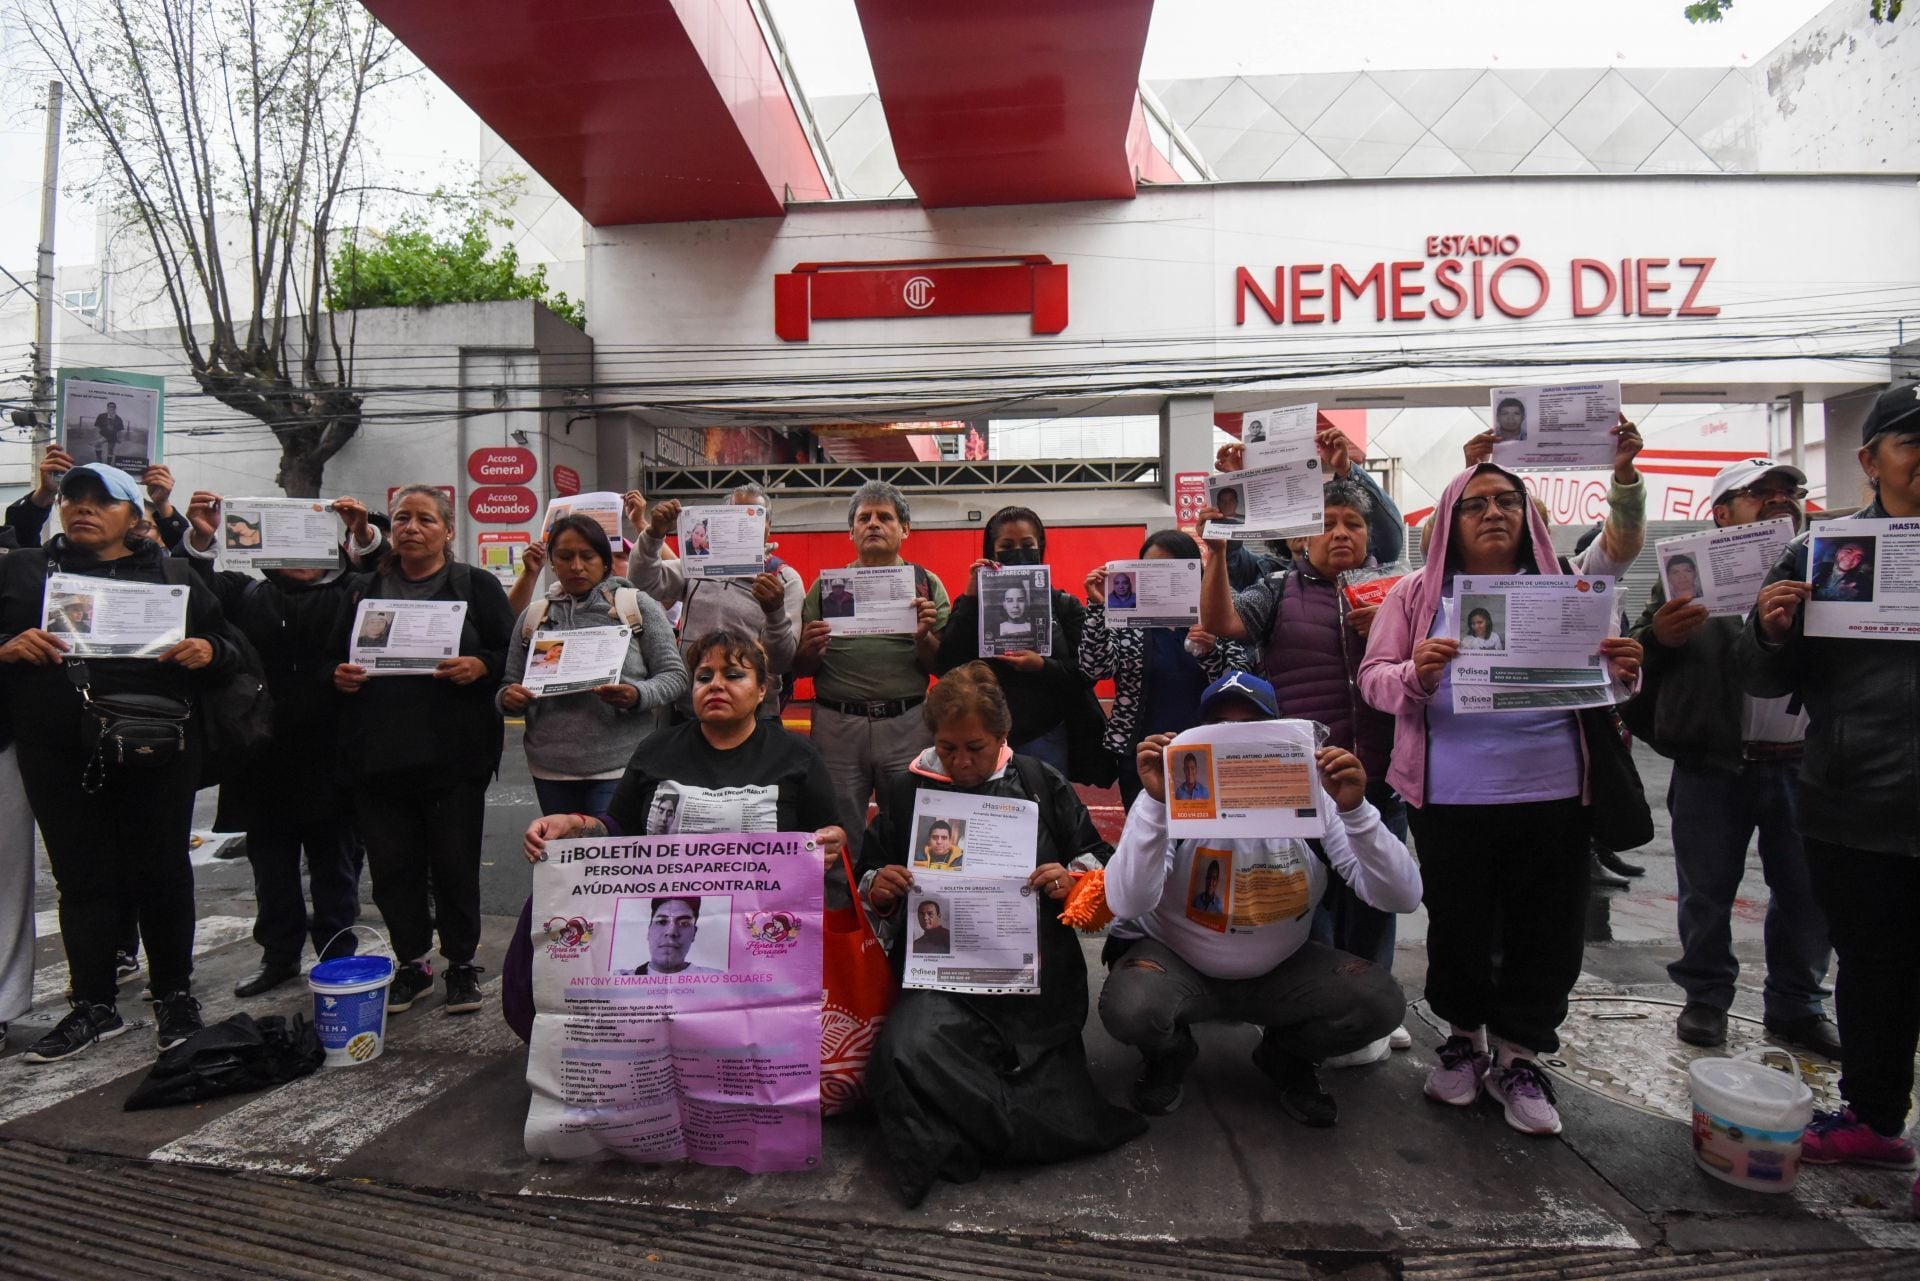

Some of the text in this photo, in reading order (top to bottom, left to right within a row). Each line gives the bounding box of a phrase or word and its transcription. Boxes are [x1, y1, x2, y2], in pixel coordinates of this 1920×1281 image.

[1427, 234, 1520, 257] ESTADIO
[1236, 257, 1721, 325] NEMESIO DIEZ
[488, 454, 517, 463] Acceso
[480, 464, 525, 475] General
[488, 493, 518, 502] Acceso
[475, 503, 530, 514] Abonados
[560, 841, 799, 864] ¡¡BOLETÍN DE URGENCIA!!
[584, 861, 771, 877] PERSONA DESAPARECIDA,
[571, 879, 782, 896] AYÚDANOS A ENCONTRARLA
[570, 972, 773, 987] ANTONY EMMANUEL BRAVO SOLARES
[632, 1132, 665, 1143] DATOS
